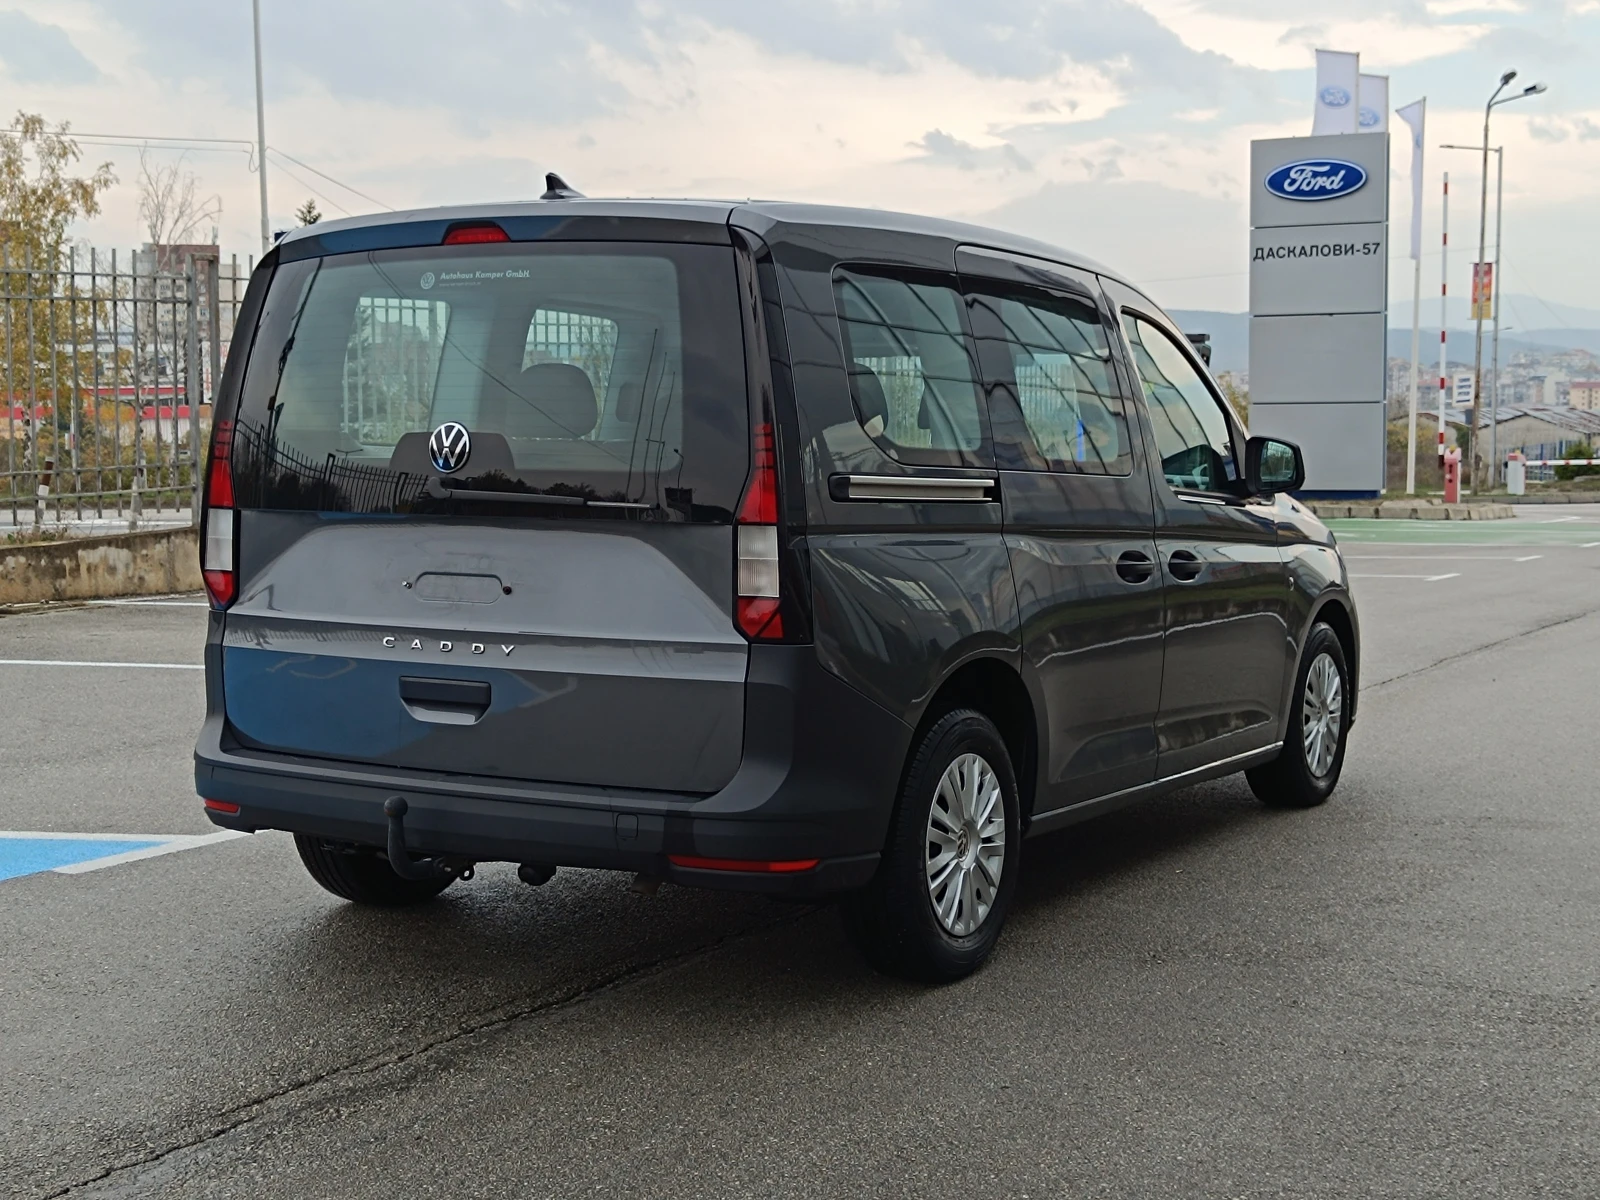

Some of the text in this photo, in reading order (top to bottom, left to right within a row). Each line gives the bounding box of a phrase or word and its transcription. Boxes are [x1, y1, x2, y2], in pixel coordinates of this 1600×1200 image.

[1283, 164, 1346, 192] Ford
[1253, 242, 1380, 261] ДАСКАЛОВИ-57
[440, 271, 474, 280] Autohaus
[505, 269, 531, 278] GmbH
[382, 636, 516, 656] CADDY
